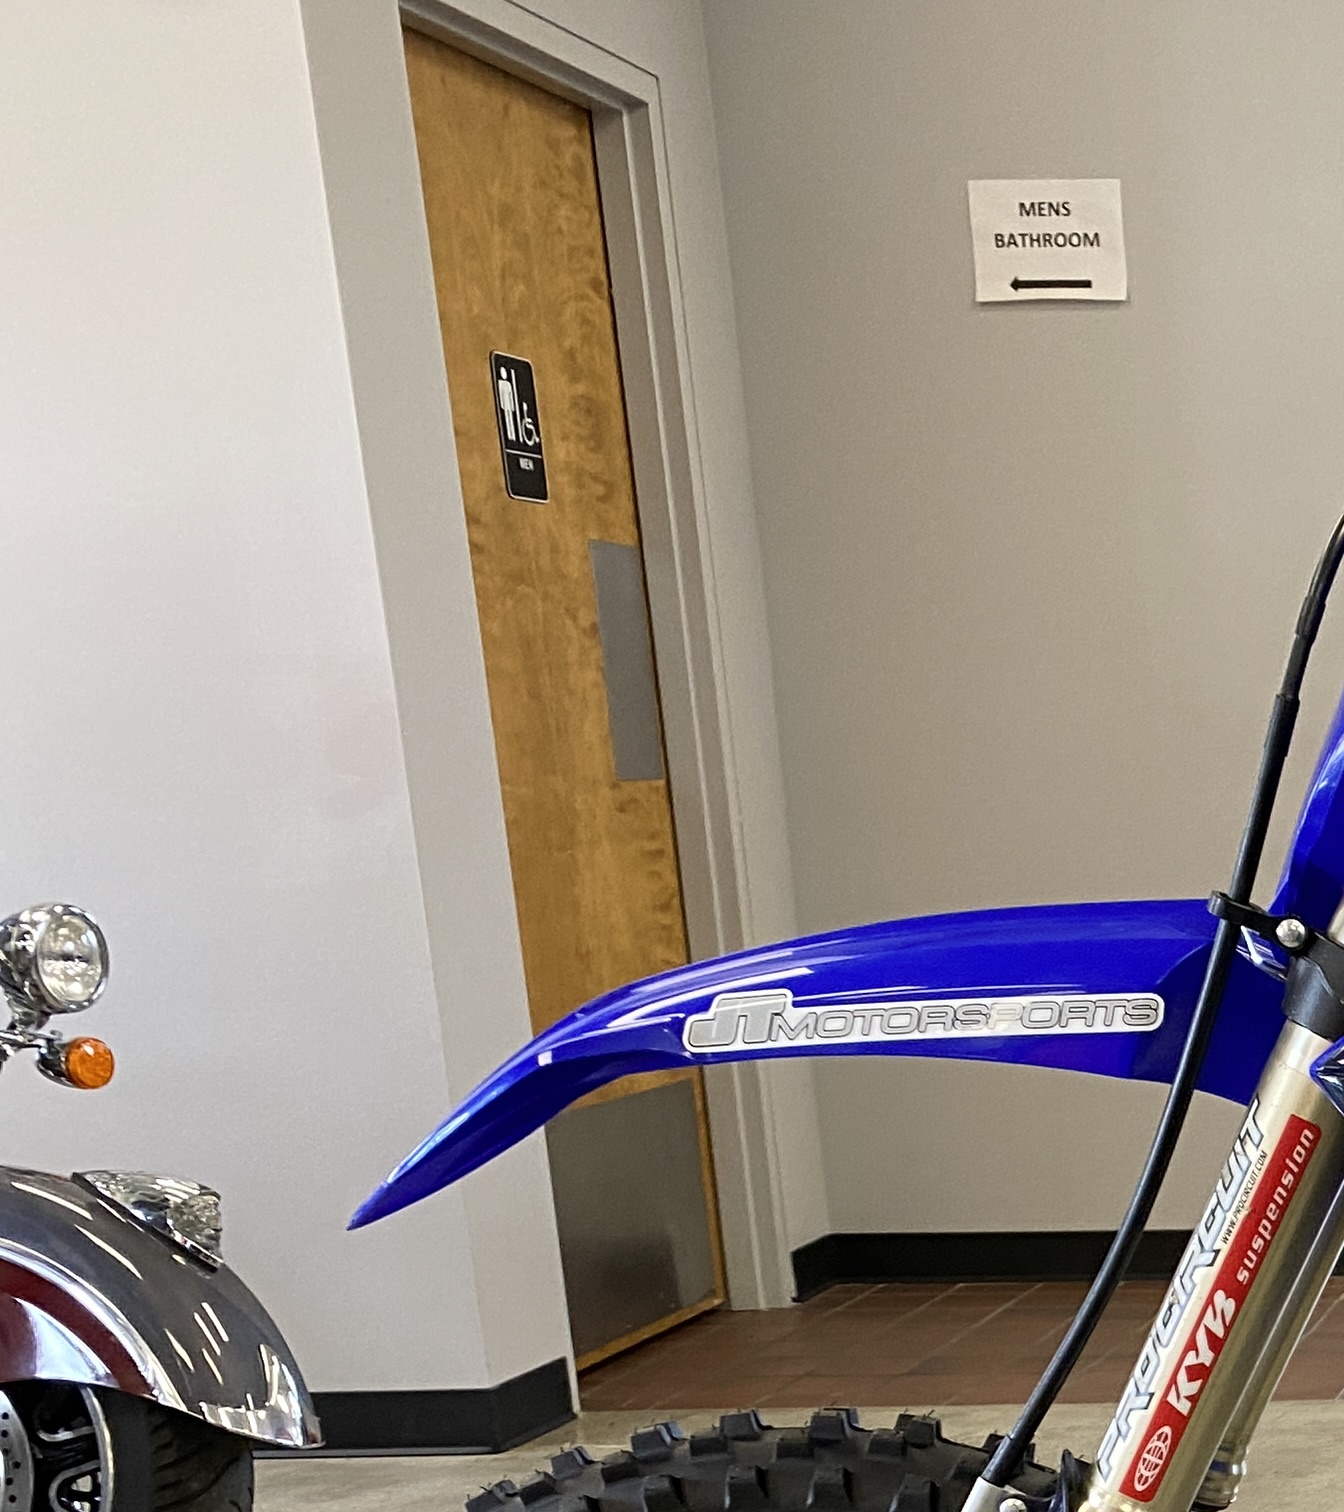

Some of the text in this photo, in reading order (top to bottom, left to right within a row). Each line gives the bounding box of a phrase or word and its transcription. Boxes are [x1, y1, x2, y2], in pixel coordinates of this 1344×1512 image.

[1018, 200, 1072, 217] MENS
[993, 231, 1101, 249] BATHROOM
[1236, 1127, 1315, 1286] suspension
